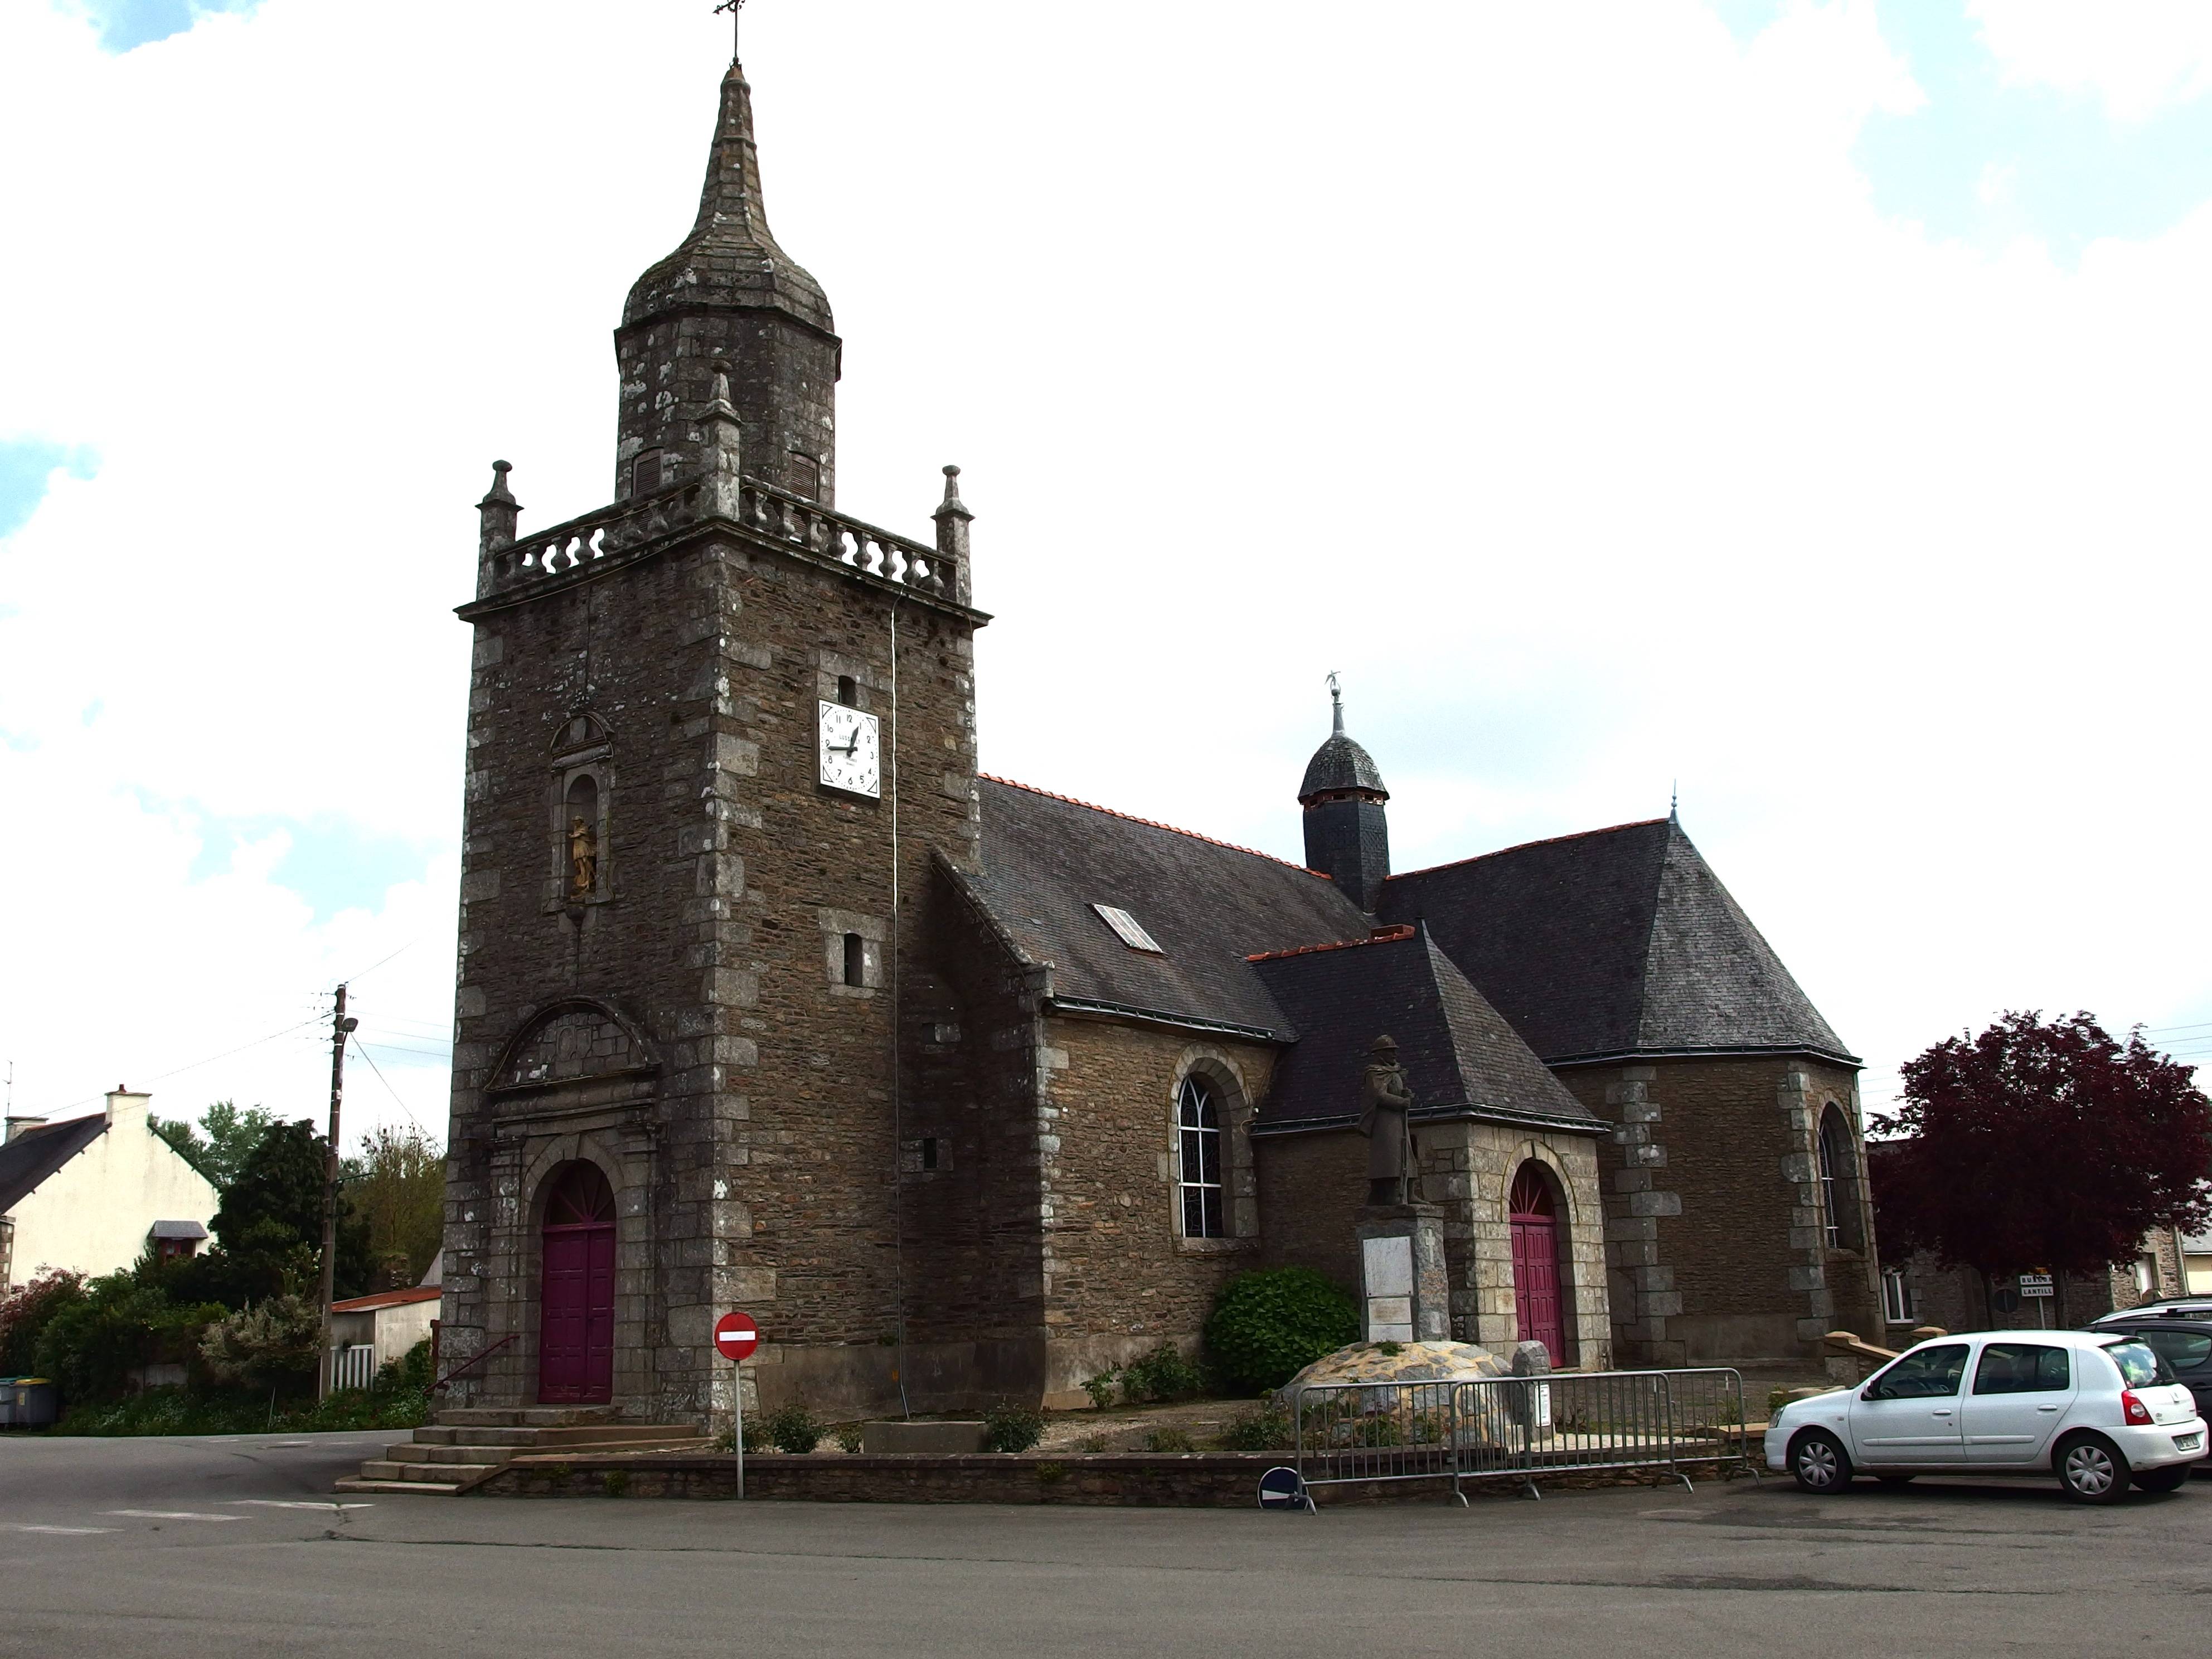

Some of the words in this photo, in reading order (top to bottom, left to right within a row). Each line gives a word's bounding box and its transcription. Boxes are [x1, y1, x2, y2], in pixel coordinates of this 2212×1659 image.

[836, 715, 841, 724] 11
[847, 715, 852, 723] 12
[827, 724, 833, 733] 10
[867, 735, 871, 744] 2
[837, 769, 842, 777] 7
[848, 777, 853, 785] 6
[860, 775, 864, 784] 5
